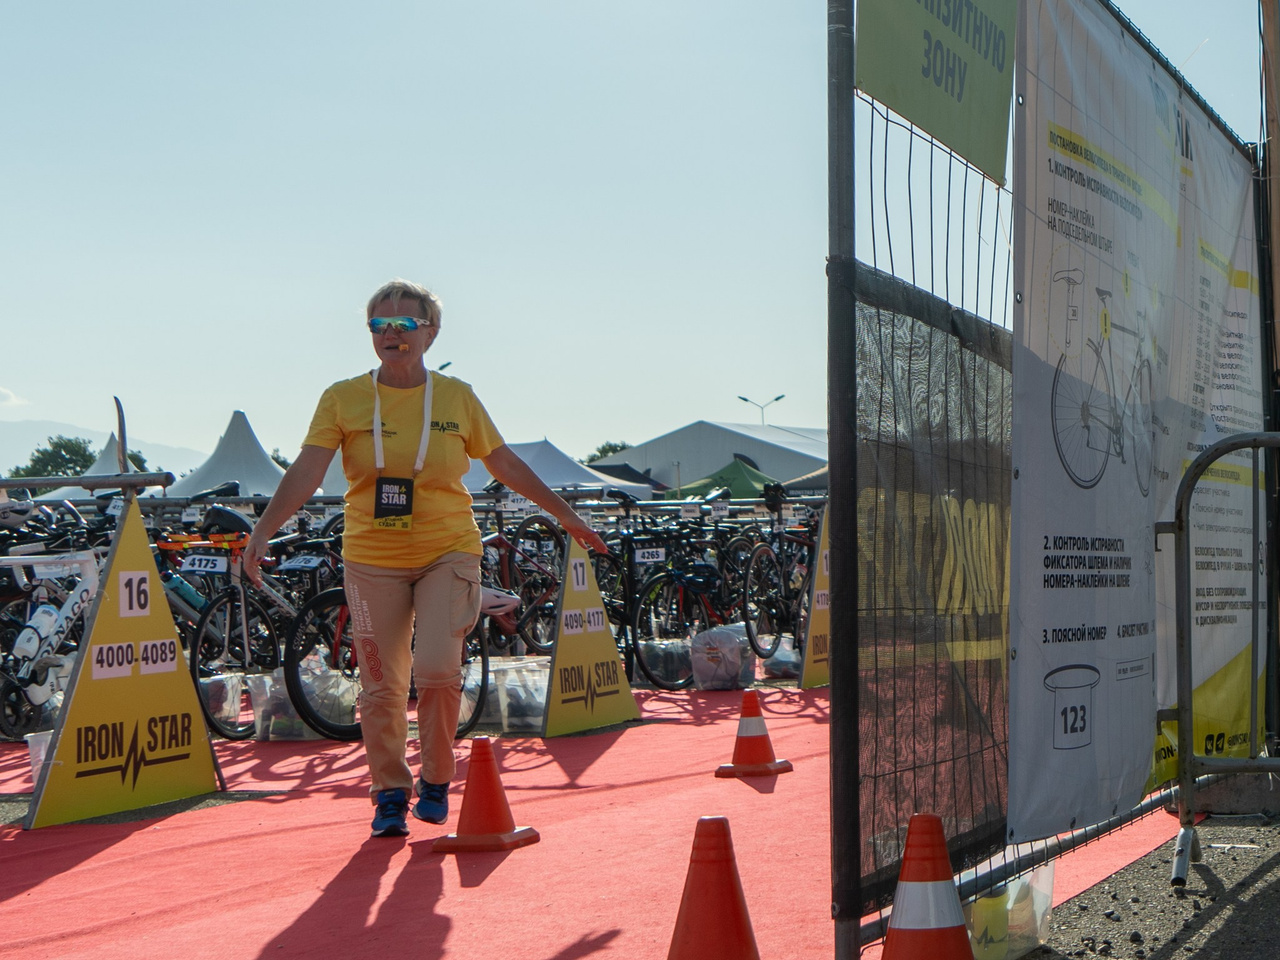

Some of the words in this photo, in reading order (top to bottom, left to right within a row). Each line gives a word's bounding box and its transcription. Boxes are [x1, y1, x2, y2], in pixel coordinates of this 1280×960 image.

[921, 29, 968, 103] ЗОНУ
[1049, 130, 1083, 158] ПОСТАНОВКА
[1048, 157, 1054, 174] 1.
[1054, 160, 1086, 188] КОНТРОЛЬ
[1086, 175, 1119, 206] ИСПРАВНОСТИ
[1047, 197, 1095, 229] НОМЕР-НАКЛЕЙКА
[1047, 214, 1057, 232] НА
[1057, 218, 1098, 248] ПОДСЕДЕЛЬНОМ
[446, 421, 459, 430] STAR
[381, 493, 407, 504] STAR
[382, 484, 400, 493] IRON
[640, 550, 660, 560] 4265
[1043, 535, 1052, 550] 2.
[1053, 535, 1090, 552] КОНТРОЛЬ
[1090, 537, 1125, 552] ИСПРАВНОСТИ
[188, 556, 217, 569] 4175
[573, 562, 586, 587] 17
[1043, 554, 1087, 570] ФИКСАТОРА
[1087, 555, 1108, 570] ШЛЕМА
[124, 576, 150, 611] 16
[1043, 571, 1109, 589] НОМЕРА-НАКЛЕЙКИ
[1109, 573, 1116, 588] НА
[354, 584, 366, 631] ТРИАТЛОНА
[362, 600, 374, 632] РОССИИ
[564, 610, 605, 630] 4090-4177
[41, 588, 90, 658] OLNAGO
[1042, 628, 1050, 644] 3.
[1051, 623, 1087, 643] ПОЯСНОЙ
[1087, 626, 1107, 641] НОМЕР
[95, 641, 177, 668] 4000-4089
[812, 634, 828, 655] IRON
[559, 665, 585, 694] IRON
[595, 660, 619, 688] STAR
[1060, 704, 1087, 734] 123
[76, 721, 124, 764] IRON
[147, 712, 192, 753] STAR
